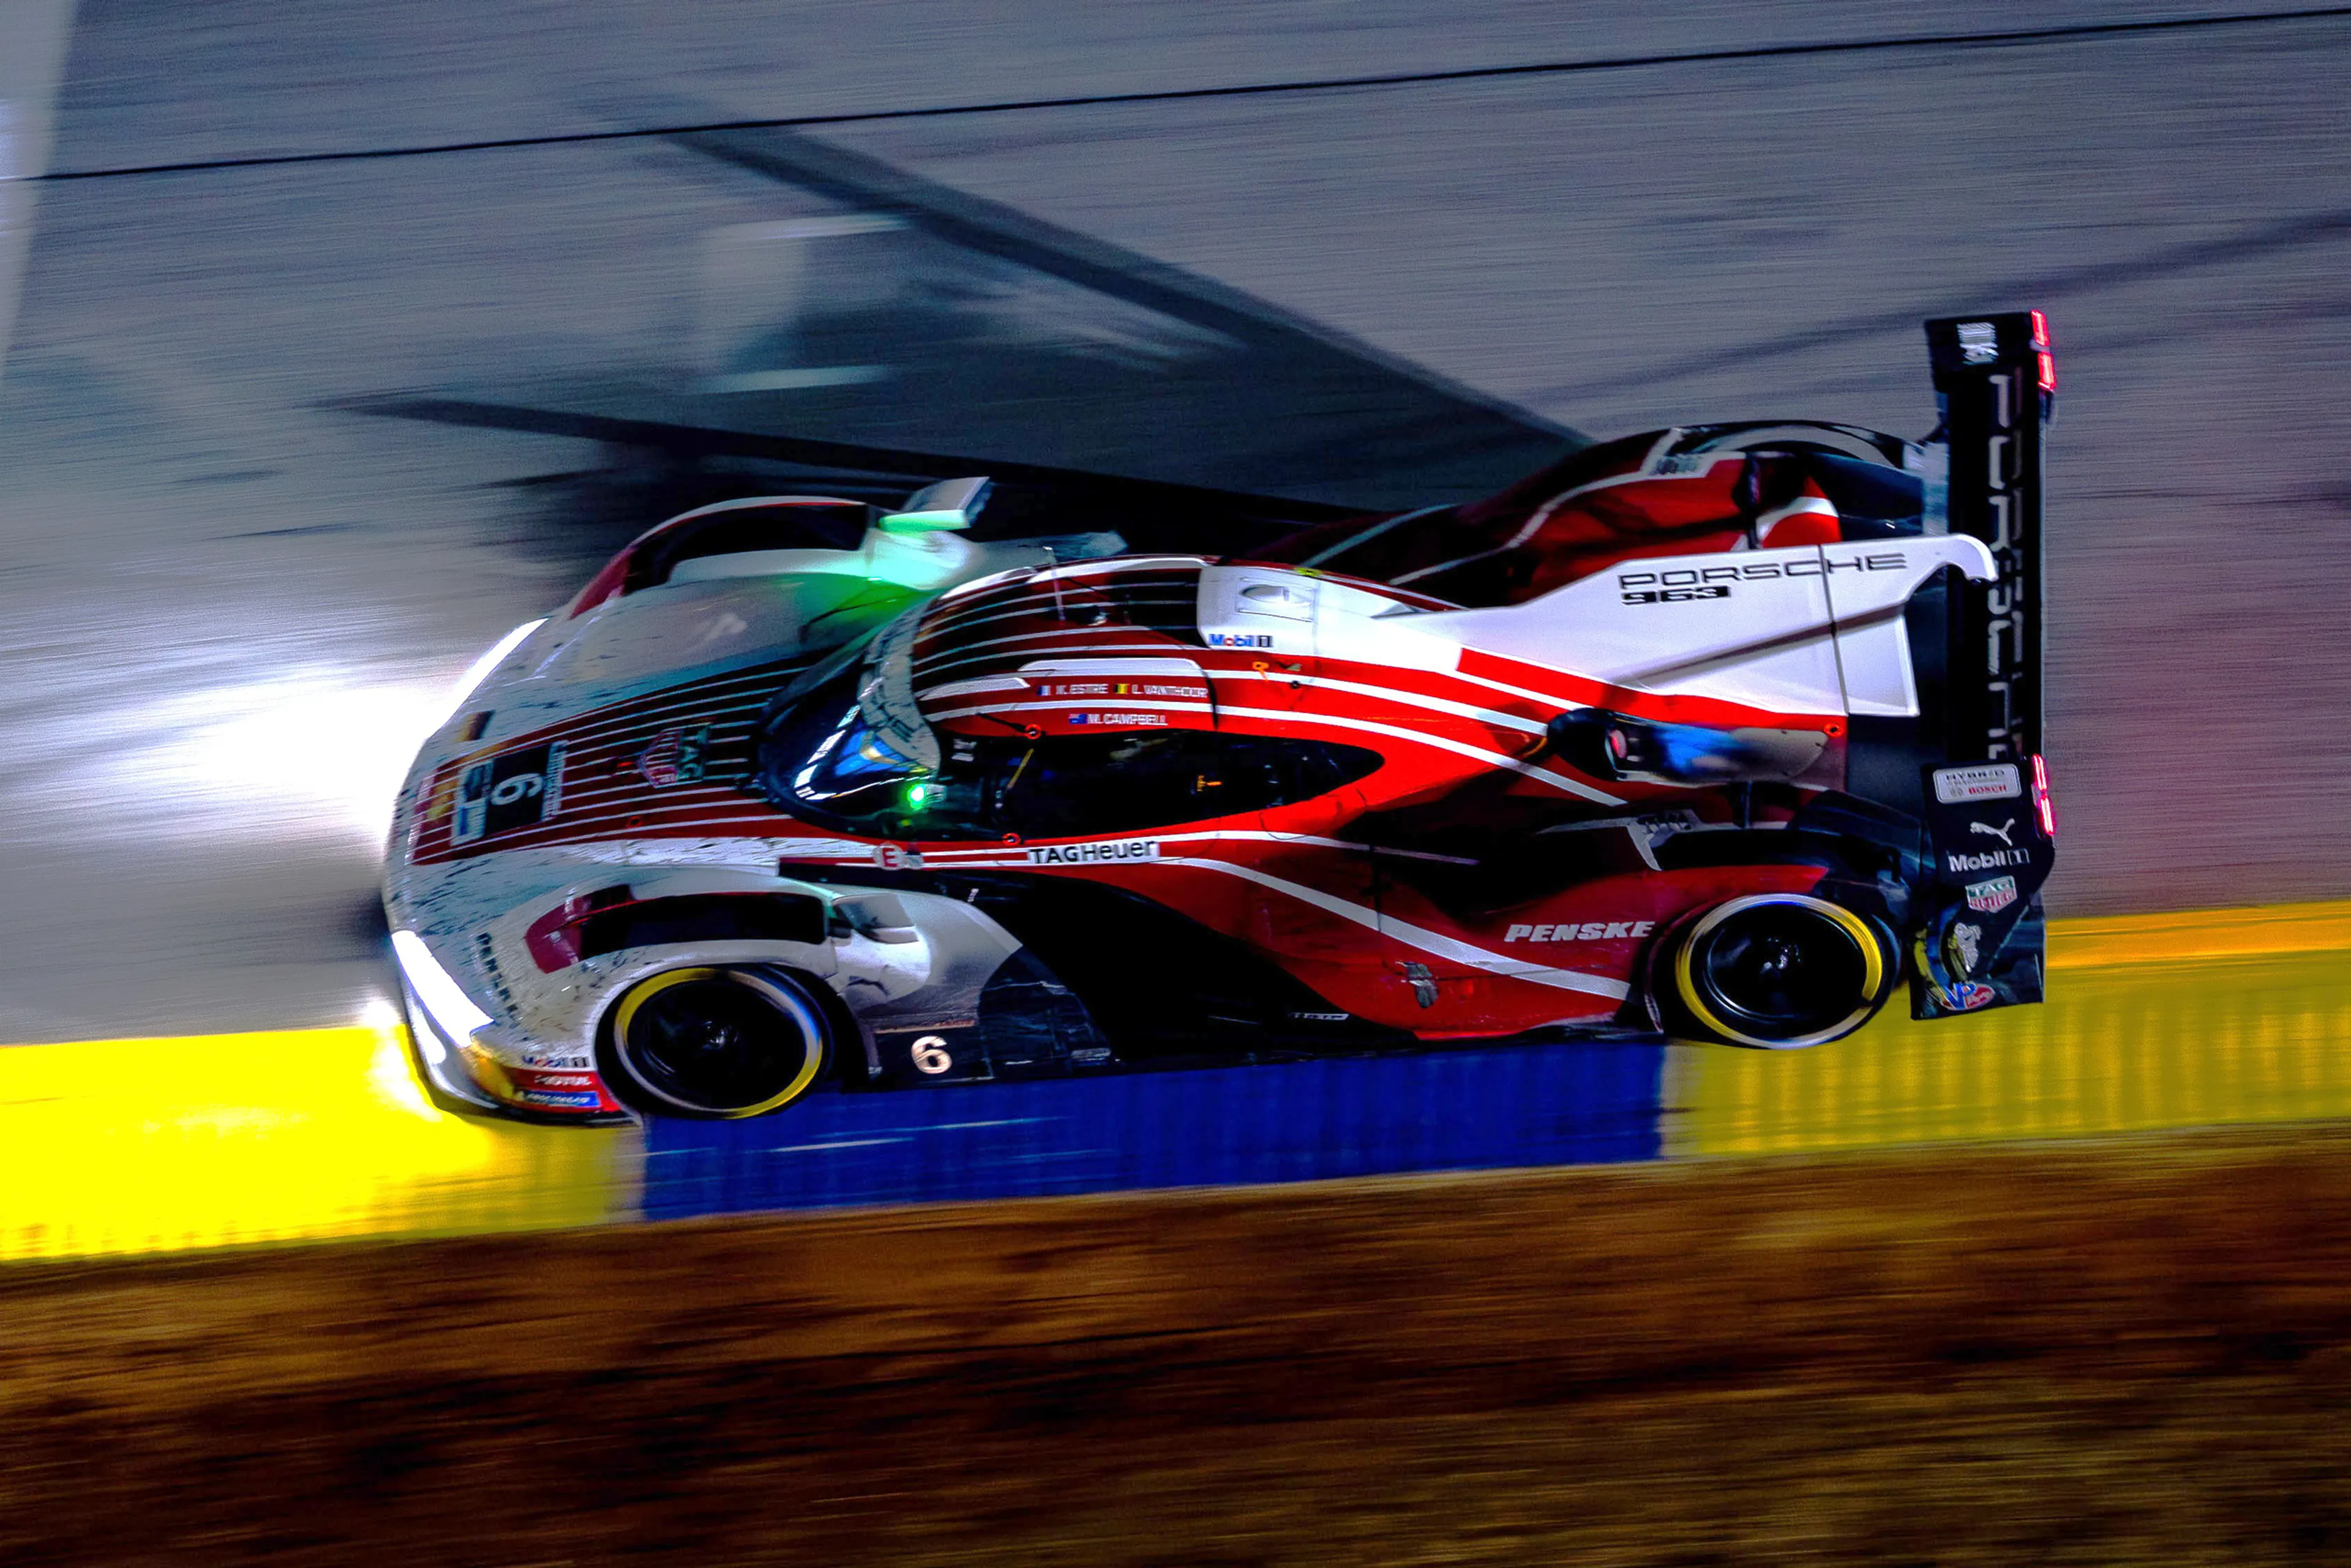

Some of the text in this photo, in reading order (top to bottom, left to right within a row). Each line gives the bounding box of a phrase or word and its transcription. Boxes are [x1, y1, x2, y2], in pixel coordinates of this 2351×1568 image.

[1618, 553, 1907, 589] PORSCHE
[1621, 585, 1731, 606] 963
[1209, 634, 1254, 647] Mobil
[490, 772, 544, 806] 6
[882, 847, 900, 867] E
[1948, 850, 2007, 872] Mobil
[1504, 921, 1655, 942] PENSKE
[911, 1035, 953, 1074] 6
